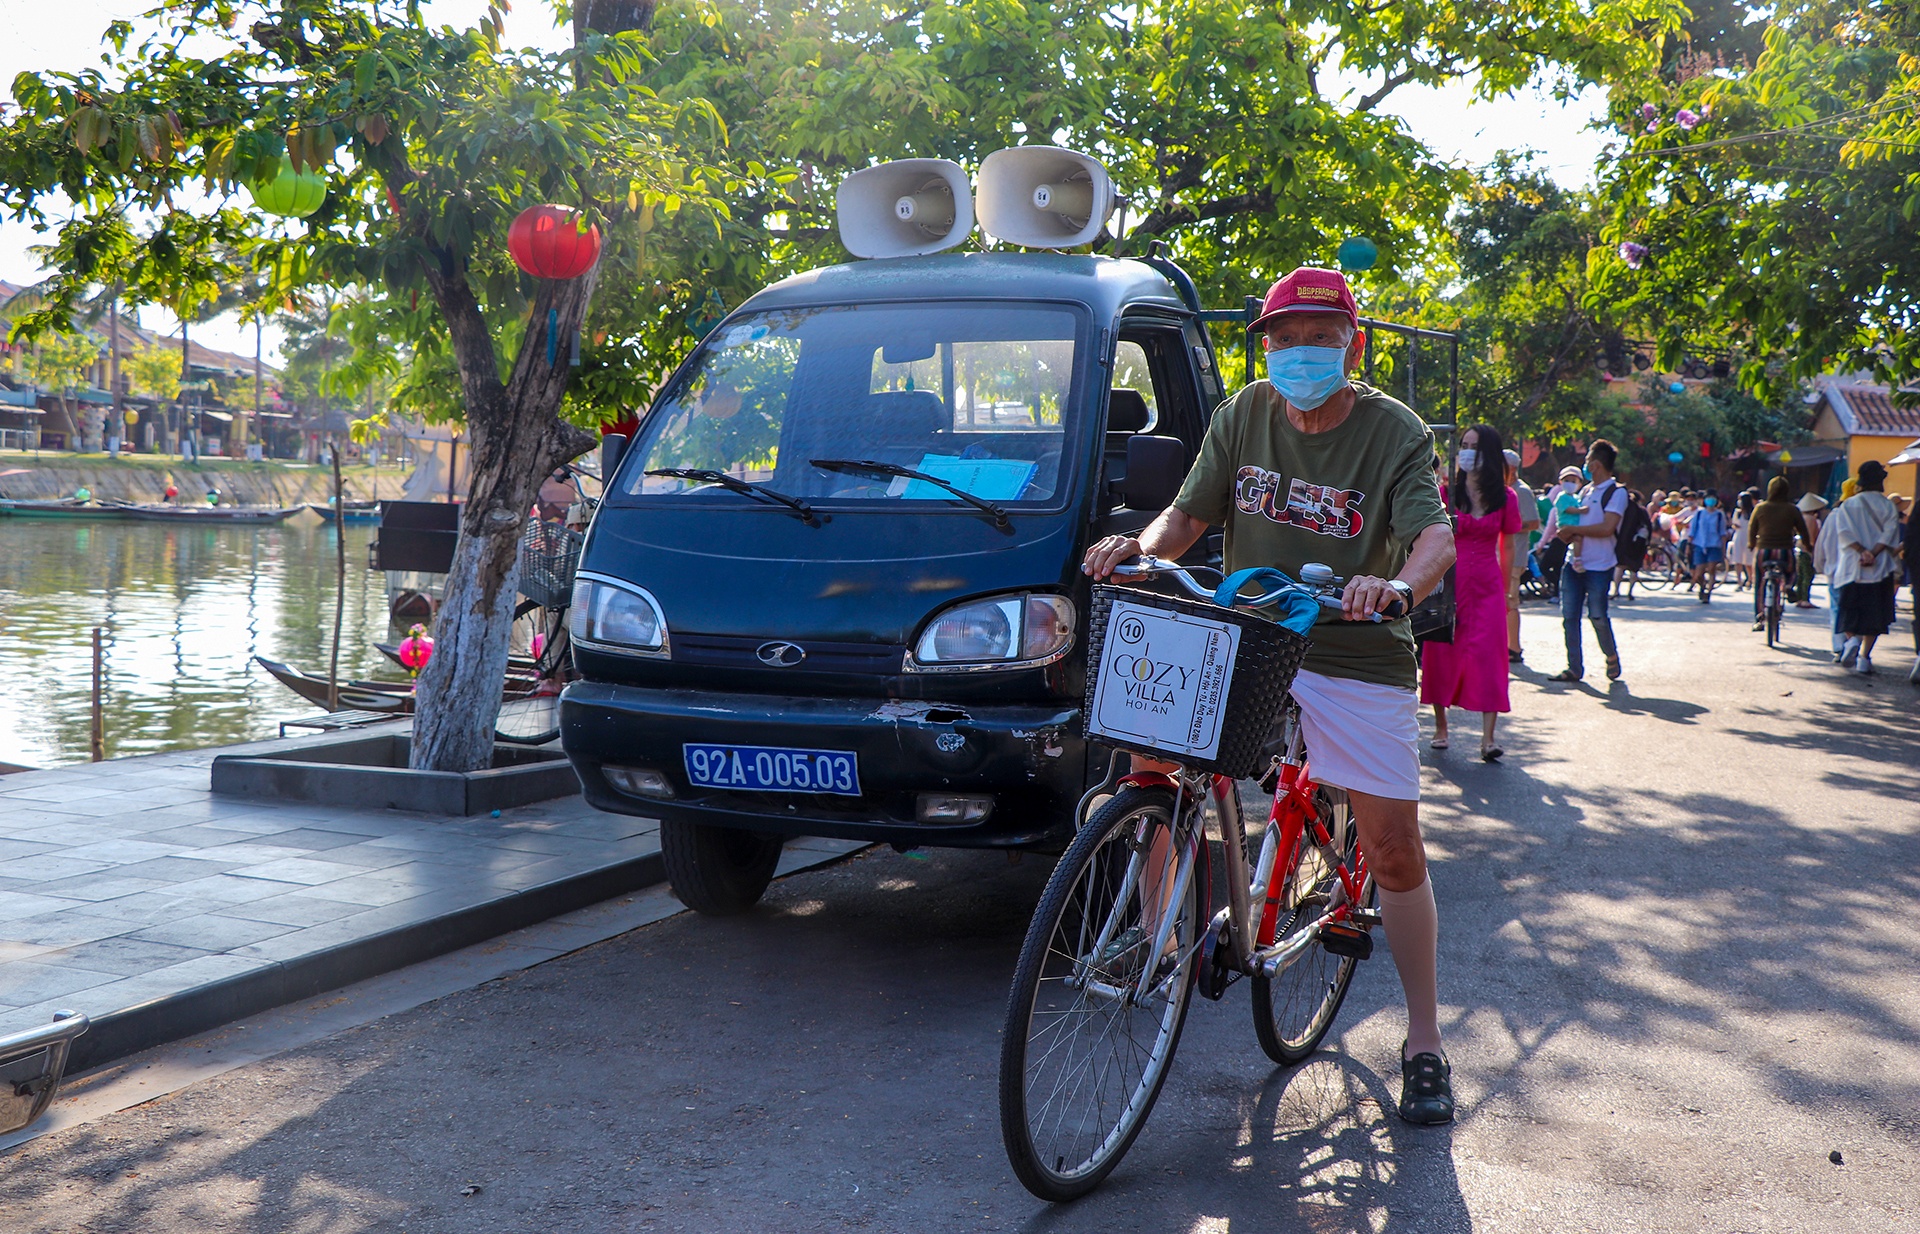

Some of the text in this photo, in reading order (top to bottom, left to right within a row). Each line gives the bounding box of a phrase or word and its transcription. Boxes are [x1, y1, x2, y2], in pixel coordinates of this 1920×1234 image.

[1235, 465, 1365, 539] GUESS
[1124, 623, 1141, 639] 10
[1113, 653, 1196, 691] COZY
[1197, 703, 1207, 716] Duy
[1204, 670, 1212, 679] An
[1211, 633, 1220, 646] Nam
[1124, 680, 1175, 706] VILLA
[1126, 699, 1168, 715] HOI AN
[1206, 705, 1215, 717] Tel:
[692, 749, 853, 790] 92A-005.03
